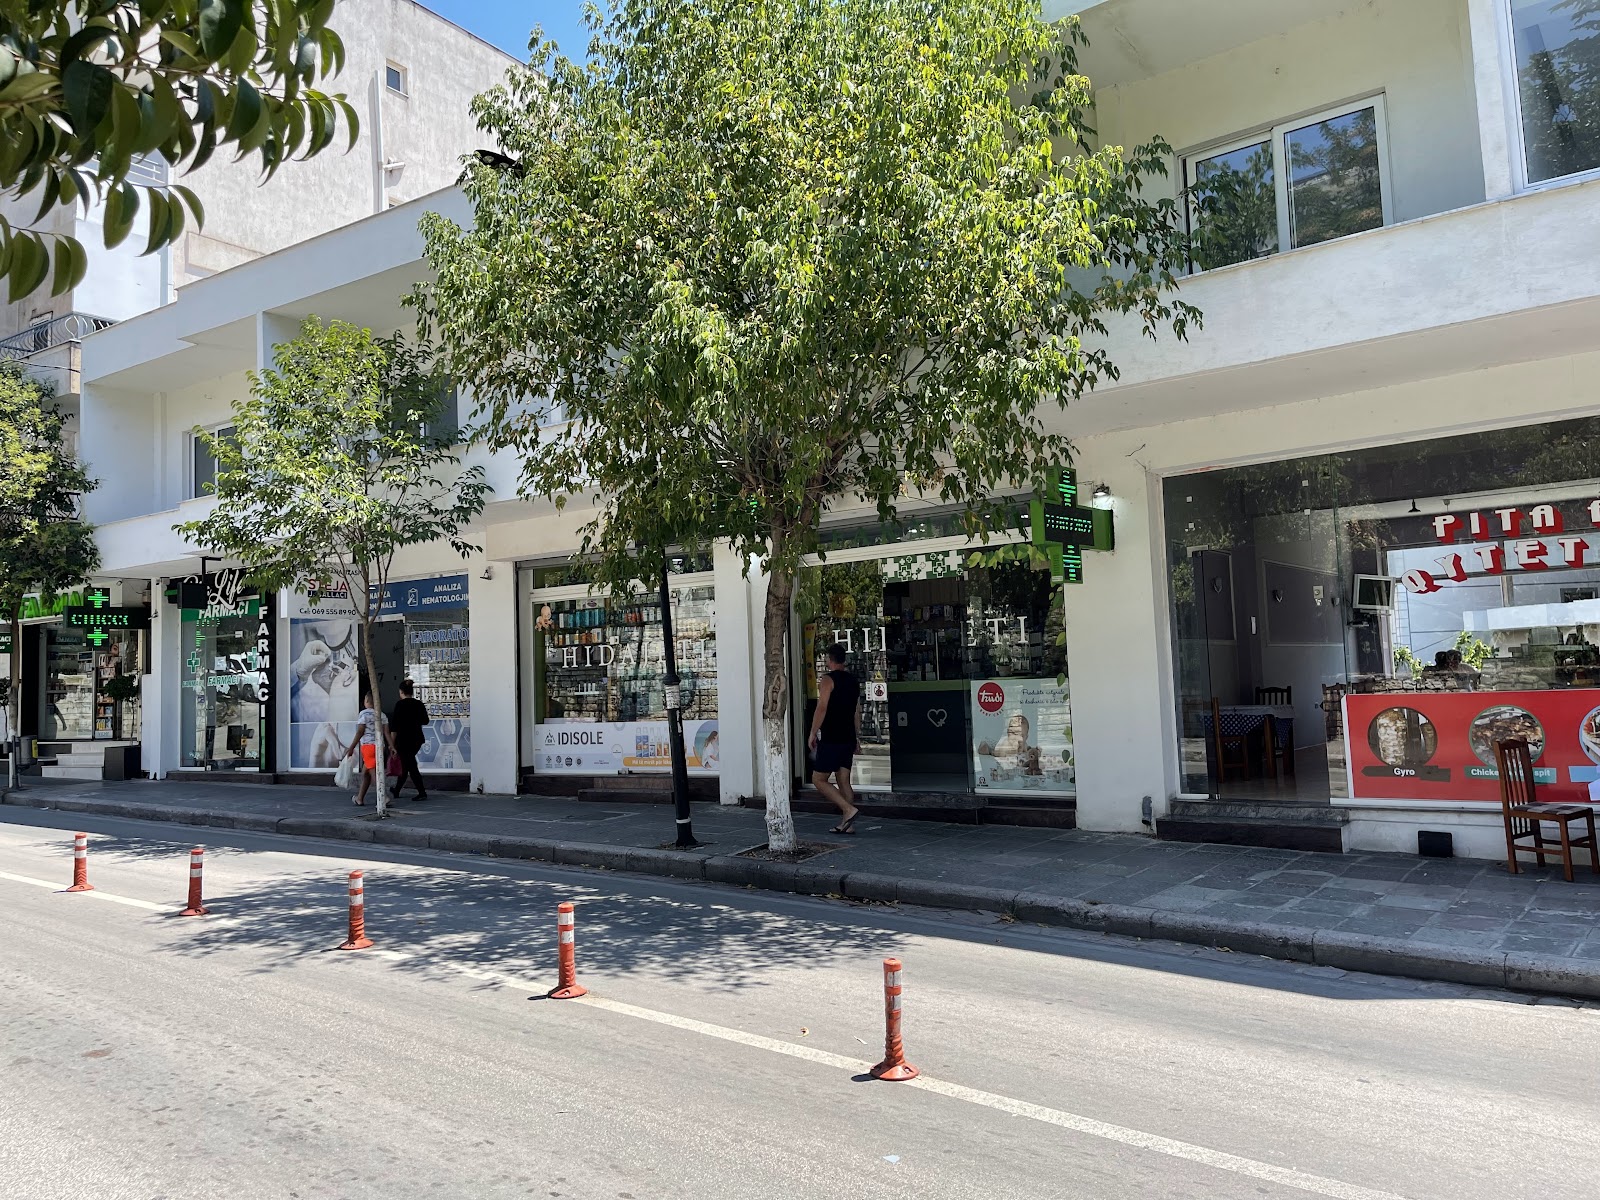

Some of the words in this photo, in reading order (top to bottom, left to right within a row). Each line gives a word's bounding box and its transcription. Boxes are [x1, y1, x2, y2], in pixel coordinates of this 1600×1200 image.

[1433, 504, 1564, 544] PITA
[433, 582, 462, 593] ANALIZA
[257, 605, 270, 718] FARMACI
[207, 675, 240, 687] FARMACI
[557, 731, 604, 746] IDISOLE
[1393, 767, 1416, 778] Gyro
[1470, 768, 1499, 776] Chicke
[1534, 768, 1551, 778] spit
